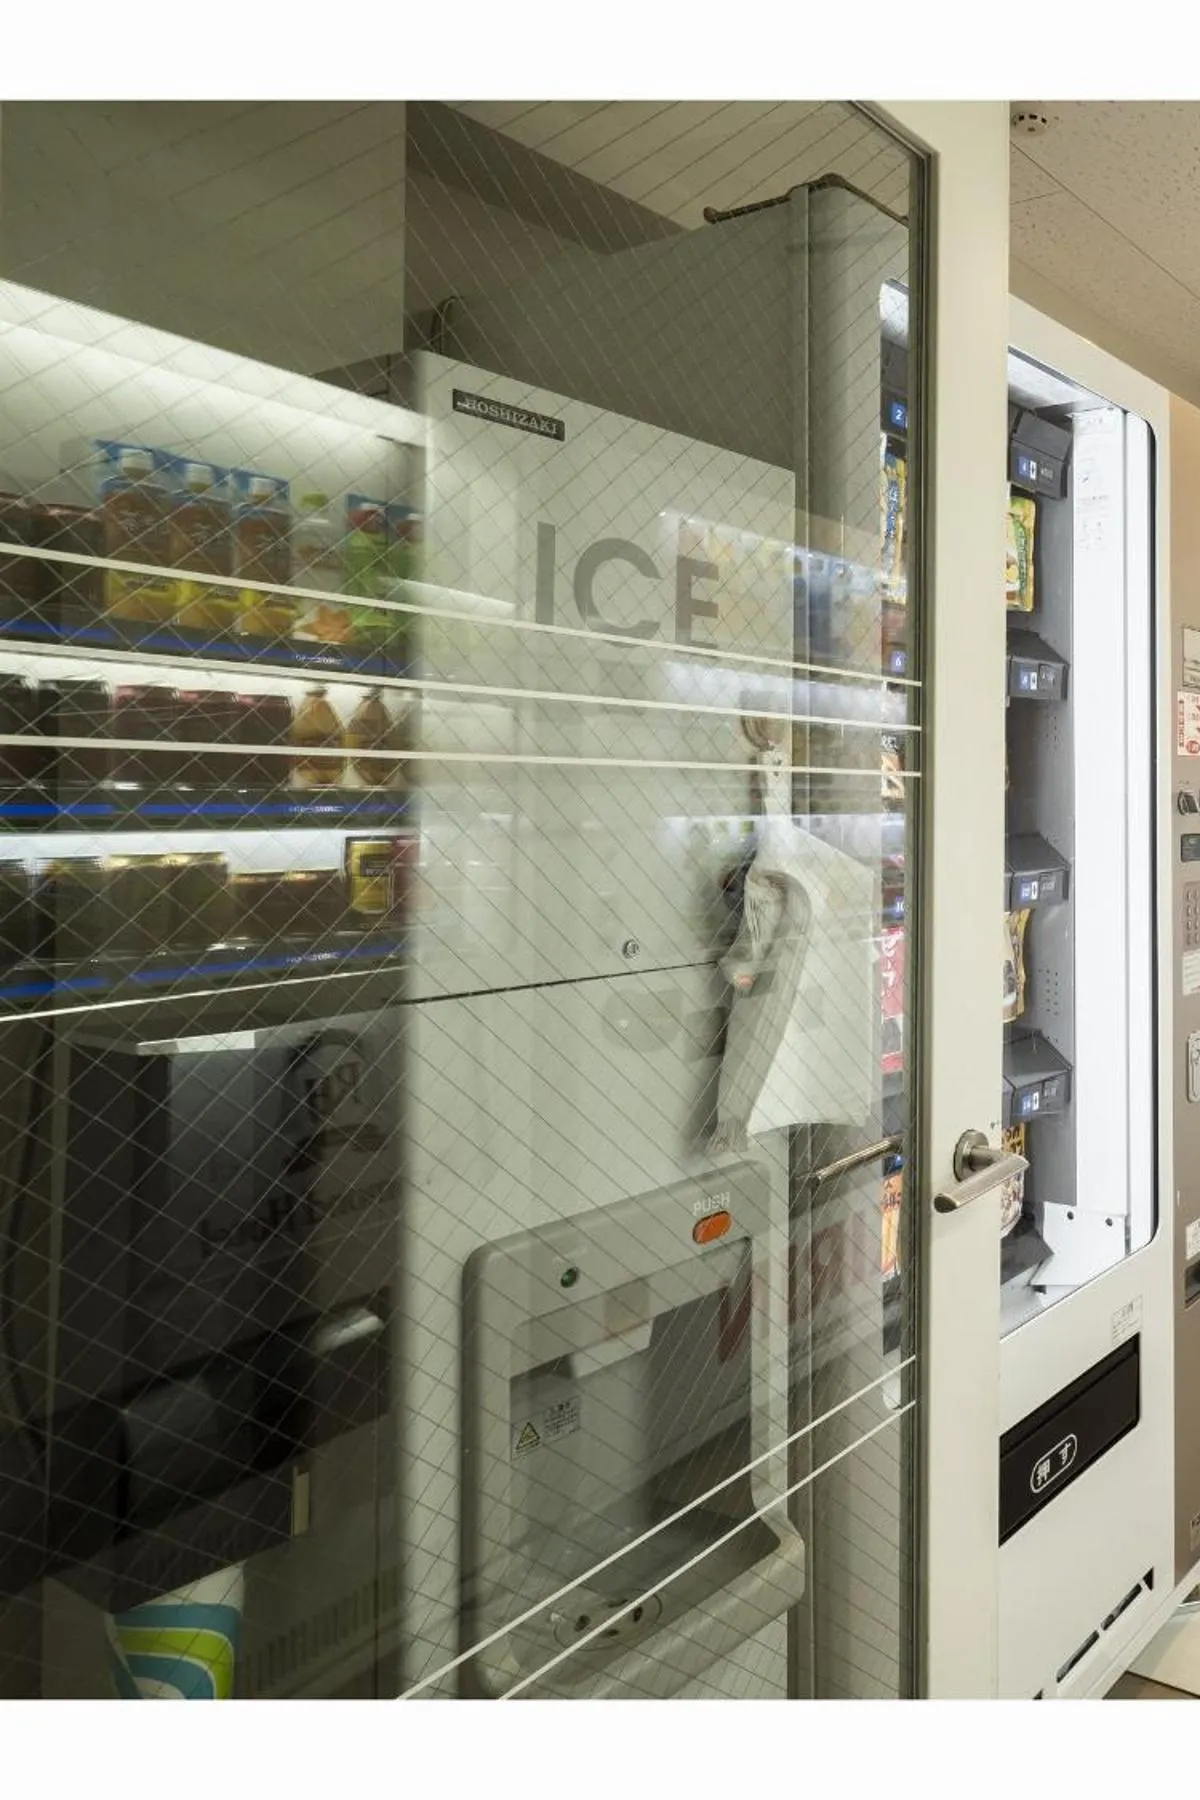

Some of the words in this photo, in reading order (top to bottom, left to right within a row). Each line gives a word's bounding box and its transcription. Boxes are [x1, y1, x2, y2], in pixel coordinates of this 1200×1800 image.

[457, 398, 559, 434] HOSHIZAKI
[535, 520, 720, 655] ICE
[692, 1191, 731, 1216] PUSH
[1036, 1442, 1071, 1487] 押す
